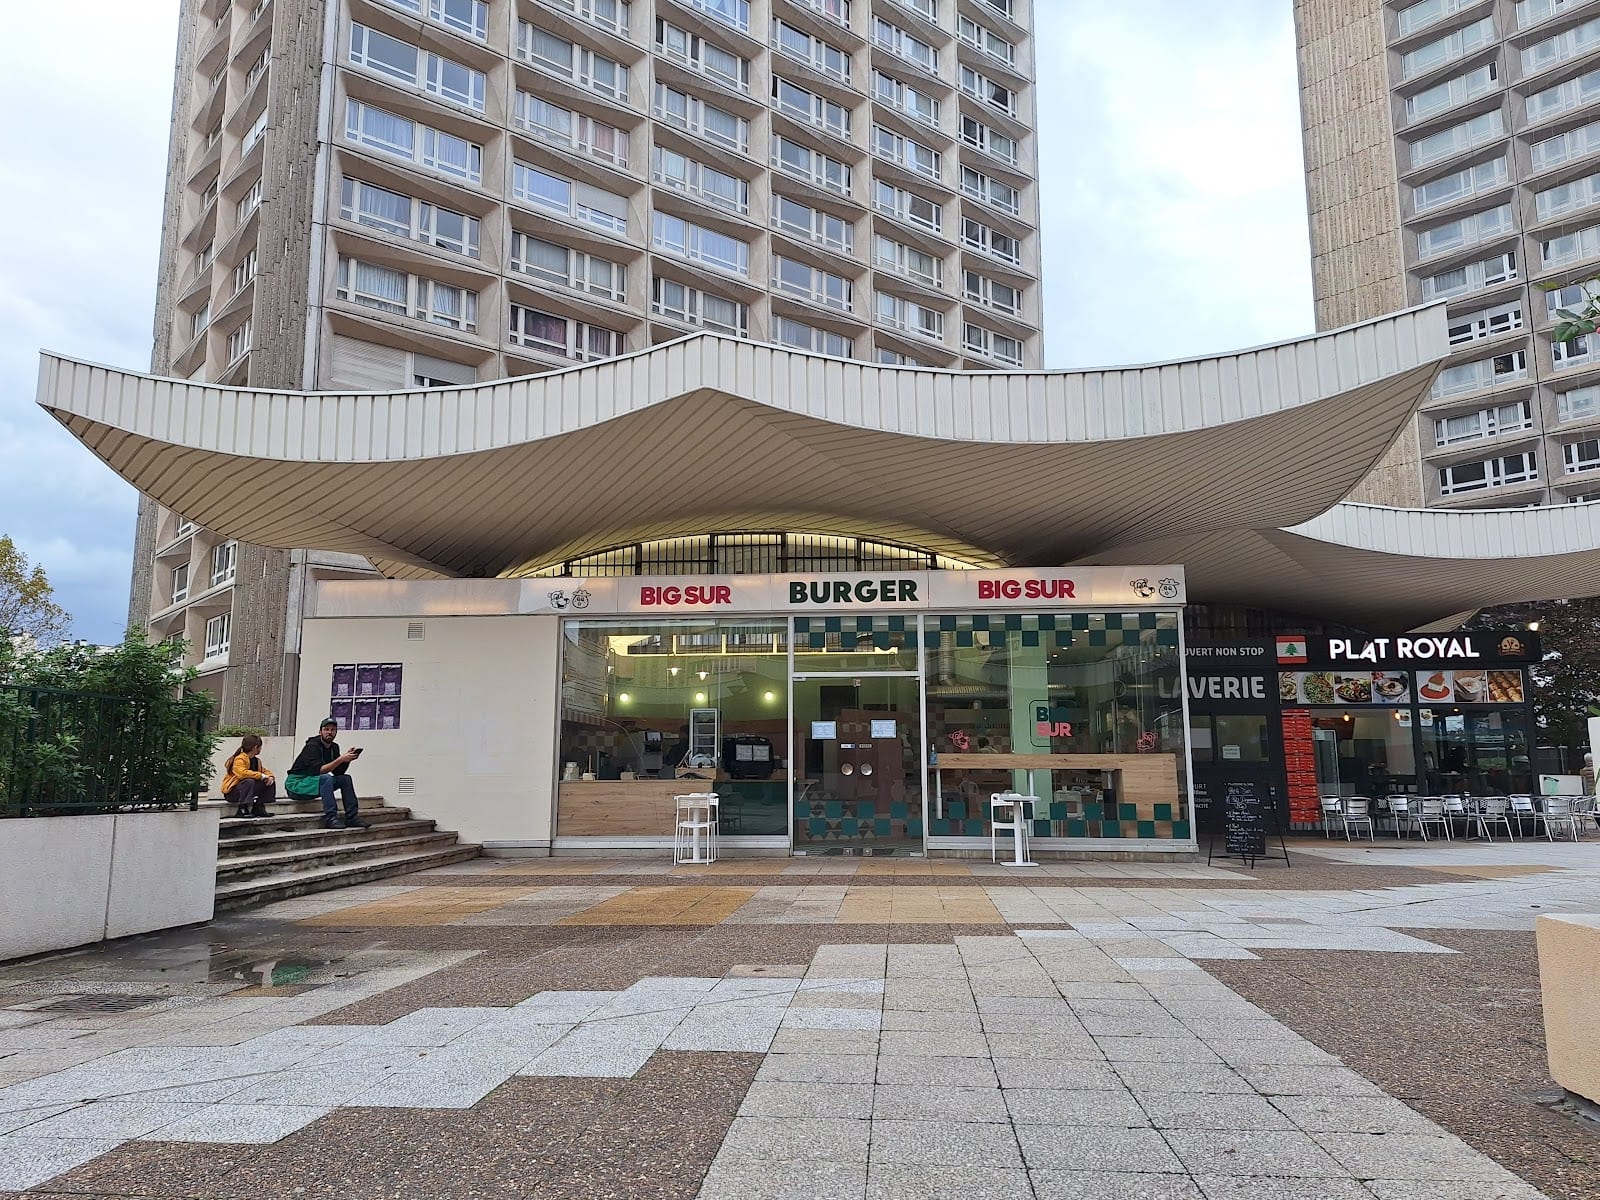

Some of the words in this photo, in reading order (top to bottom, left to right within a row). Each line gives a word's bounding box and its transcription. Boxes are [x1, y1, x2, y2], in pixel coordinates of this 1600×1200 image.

[640, 586, 681, 605] BIG
[684, 585, 732, 605] SUR
[789, 580, 919, 604] BURGER
[978, 580, 1021, 599] BIG
[1024, 579, 1076, 599] SUR
[1215, 647, 1237, 656] NON
[1239, 647, 1265, 656] STOP
[1329, 638, 1389, 663] PLAT
[1397, 637, 1480, 659] ROYAL
[1036, 722, 1072, 737] SUR
